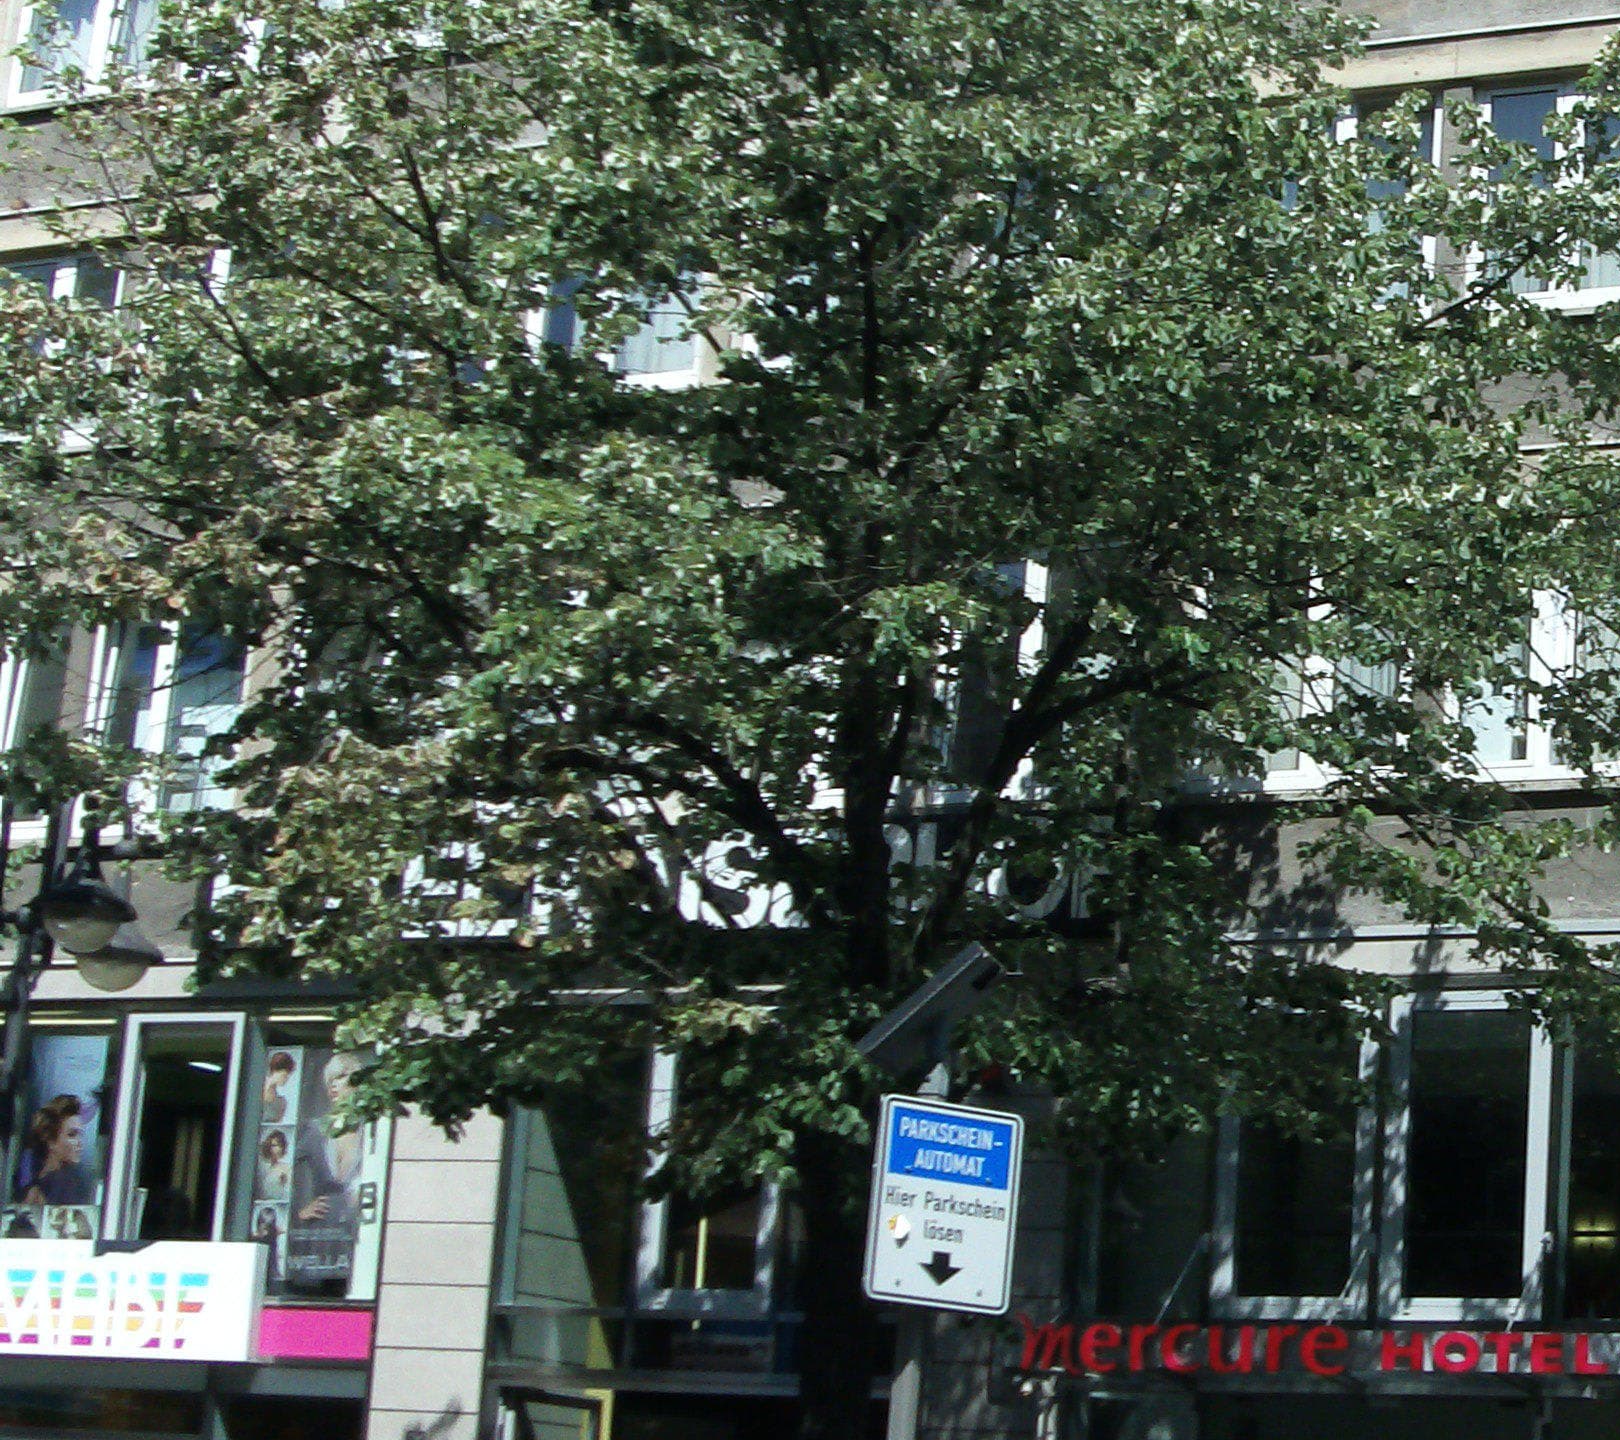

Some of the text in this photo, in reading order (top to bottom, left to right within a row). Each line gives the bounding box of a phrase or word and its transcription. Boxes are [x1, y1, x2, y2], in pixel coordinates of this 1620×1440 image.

[898, 1115, 1004, 1151] PARKSCHEIN-
[913, 1147, 986, 1178] AUTOMAT
[885, 1184, 1006, 1222] Hier Parkschein
[922, 1217, 964, 1244] lösen
[1016, 1313, 1609, 1377] mercure HOTEL
